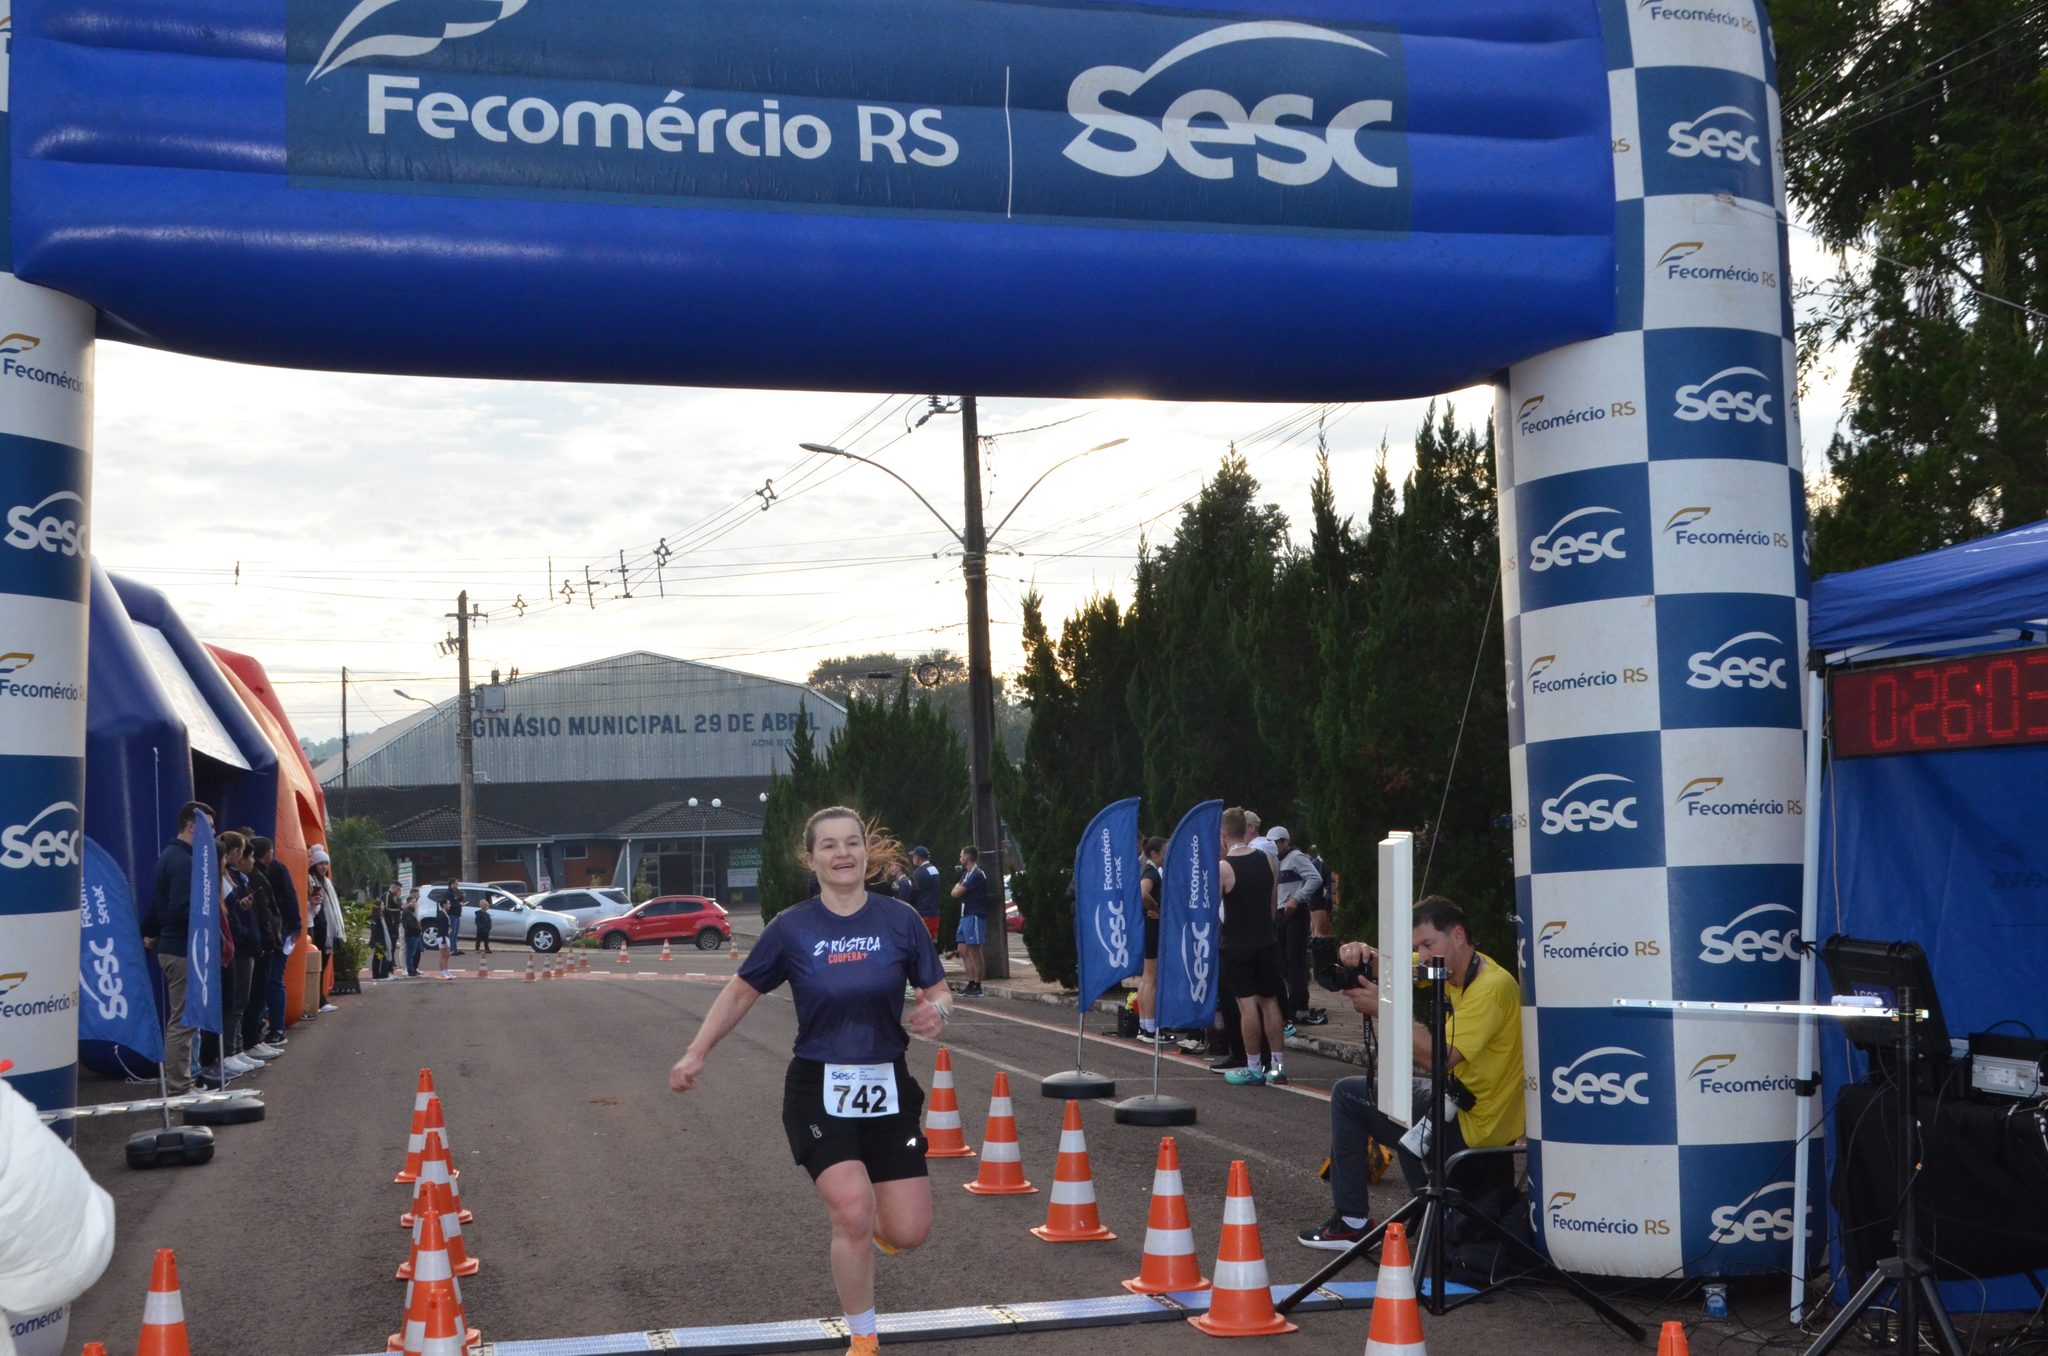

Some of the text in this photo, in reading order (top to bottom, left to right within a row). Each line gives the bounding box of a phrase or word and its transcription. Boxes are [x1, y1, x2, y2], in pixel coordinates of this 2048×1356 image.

[1650, 6, 1757, 34] Fecomércio RS
[367, 20, 1398, 188] Fecomércio RS Sesc
[1667, 105, 1761, 166] Sesc
[1668, 264, 1777, 288] Fecomércio RS
[3, 357, 84, 396] Fecomércio
[1673, 366, 1774, 425] Sesc
[1521, 401, 1637, 436] Fecomércio RS
[1529, 506, 1627, 572] Sesc
[1675, 529, 1770, 546] Fecomércio
[1773, 532, 1789, 549] RS
[1686, 631, 1787, 689] Sesc
[0, 679, 78, 701] Fecomércio
[1532, 667, 1649, 695] Fecomércio RS
[473, 712, 821, 738] GINÁSIO MUNICIPAL 29 DE ABRL
[1540, 773, 1639, 835] Sesc
[1688, 798, 1803, 816] Fecomércio RS
[1101, 828, 1113, 891] Fecomércio
[1189, 835, 1199, 909] Fecomércio
[831, 936, 881, 953] RÚSTICA
[1095, 900, 1129, 969] Sesc
[1543, 942, 1629, 959] Fecomércio
[1634, 941, 1660, 956] RS
[81, 937, 129, 1021] Sesc
[1181, 922, 1210, 1005] Sesc
[1551, 1046, 1649, 1105] Sesc
[1700, 1075, 1797, 1093] Fecomércio
[833, 1084, 888, 1114] 742
[1552, 1213, 1639, 1235] Fecomércio
[1644, 1219, 1671, 1235] RS
